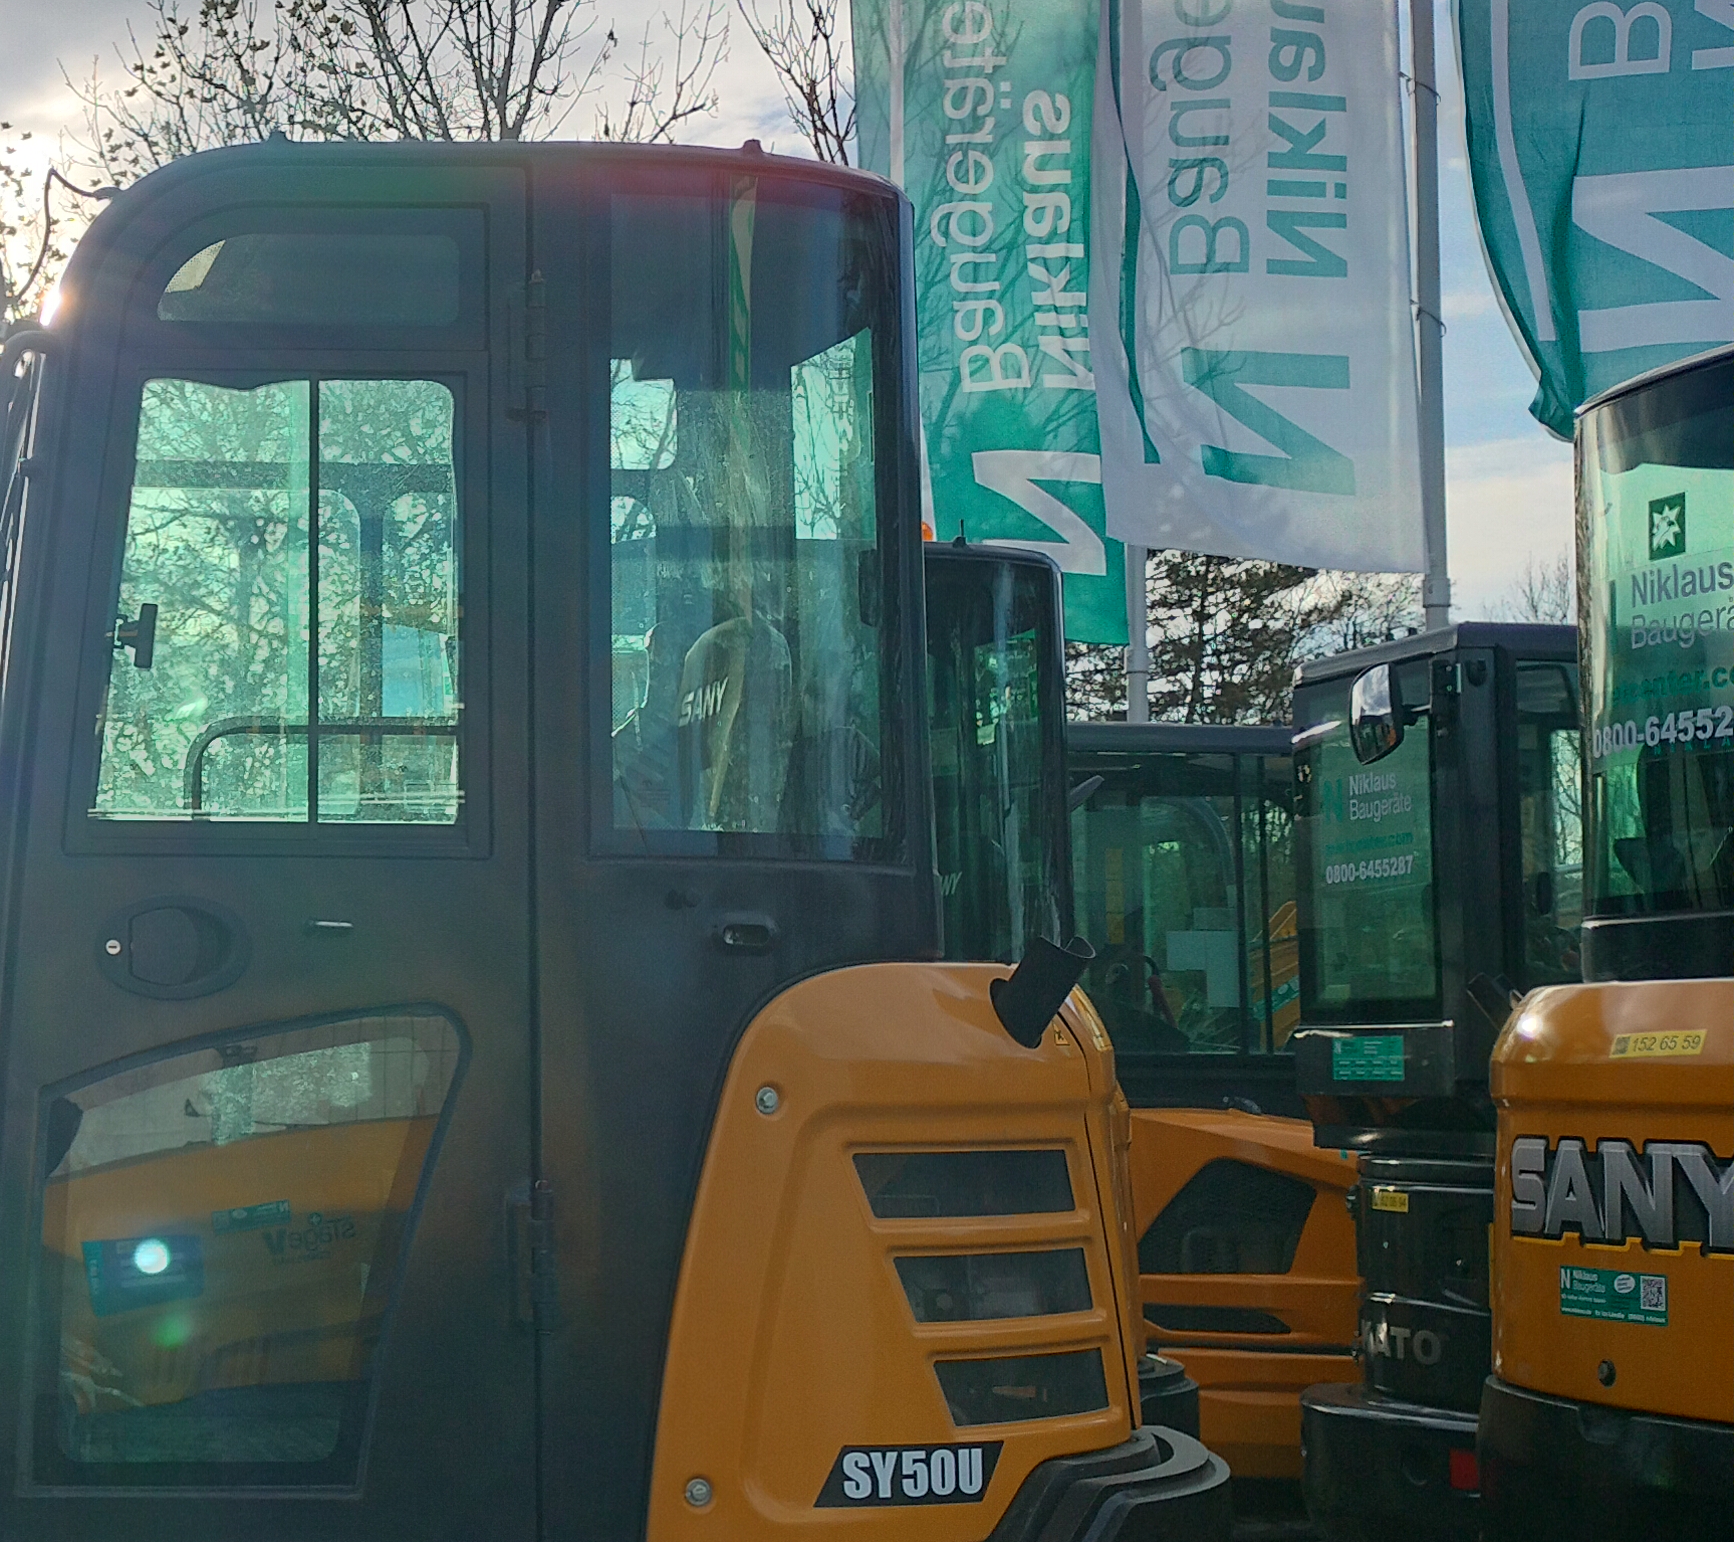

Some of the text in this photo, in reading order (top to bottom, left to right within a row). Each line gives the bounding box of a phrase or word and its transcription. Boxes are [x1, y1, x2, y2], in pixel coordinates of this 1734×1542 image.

[1631, 561, 1734, 608] Niklaus
[678, 676, 729, 727] SANY
[1349, 771, 1397, 796] Niklaus
[1349, 792, 1412, 822] Baugeräte
[1326, 854, 1413, 884] 0800-6455287
[1632, 1034, 1701, 1052] 152 65 59
[1511, 1137, 1734, 1248] SANY
[842, 1447, 983, 1499] SY50U
